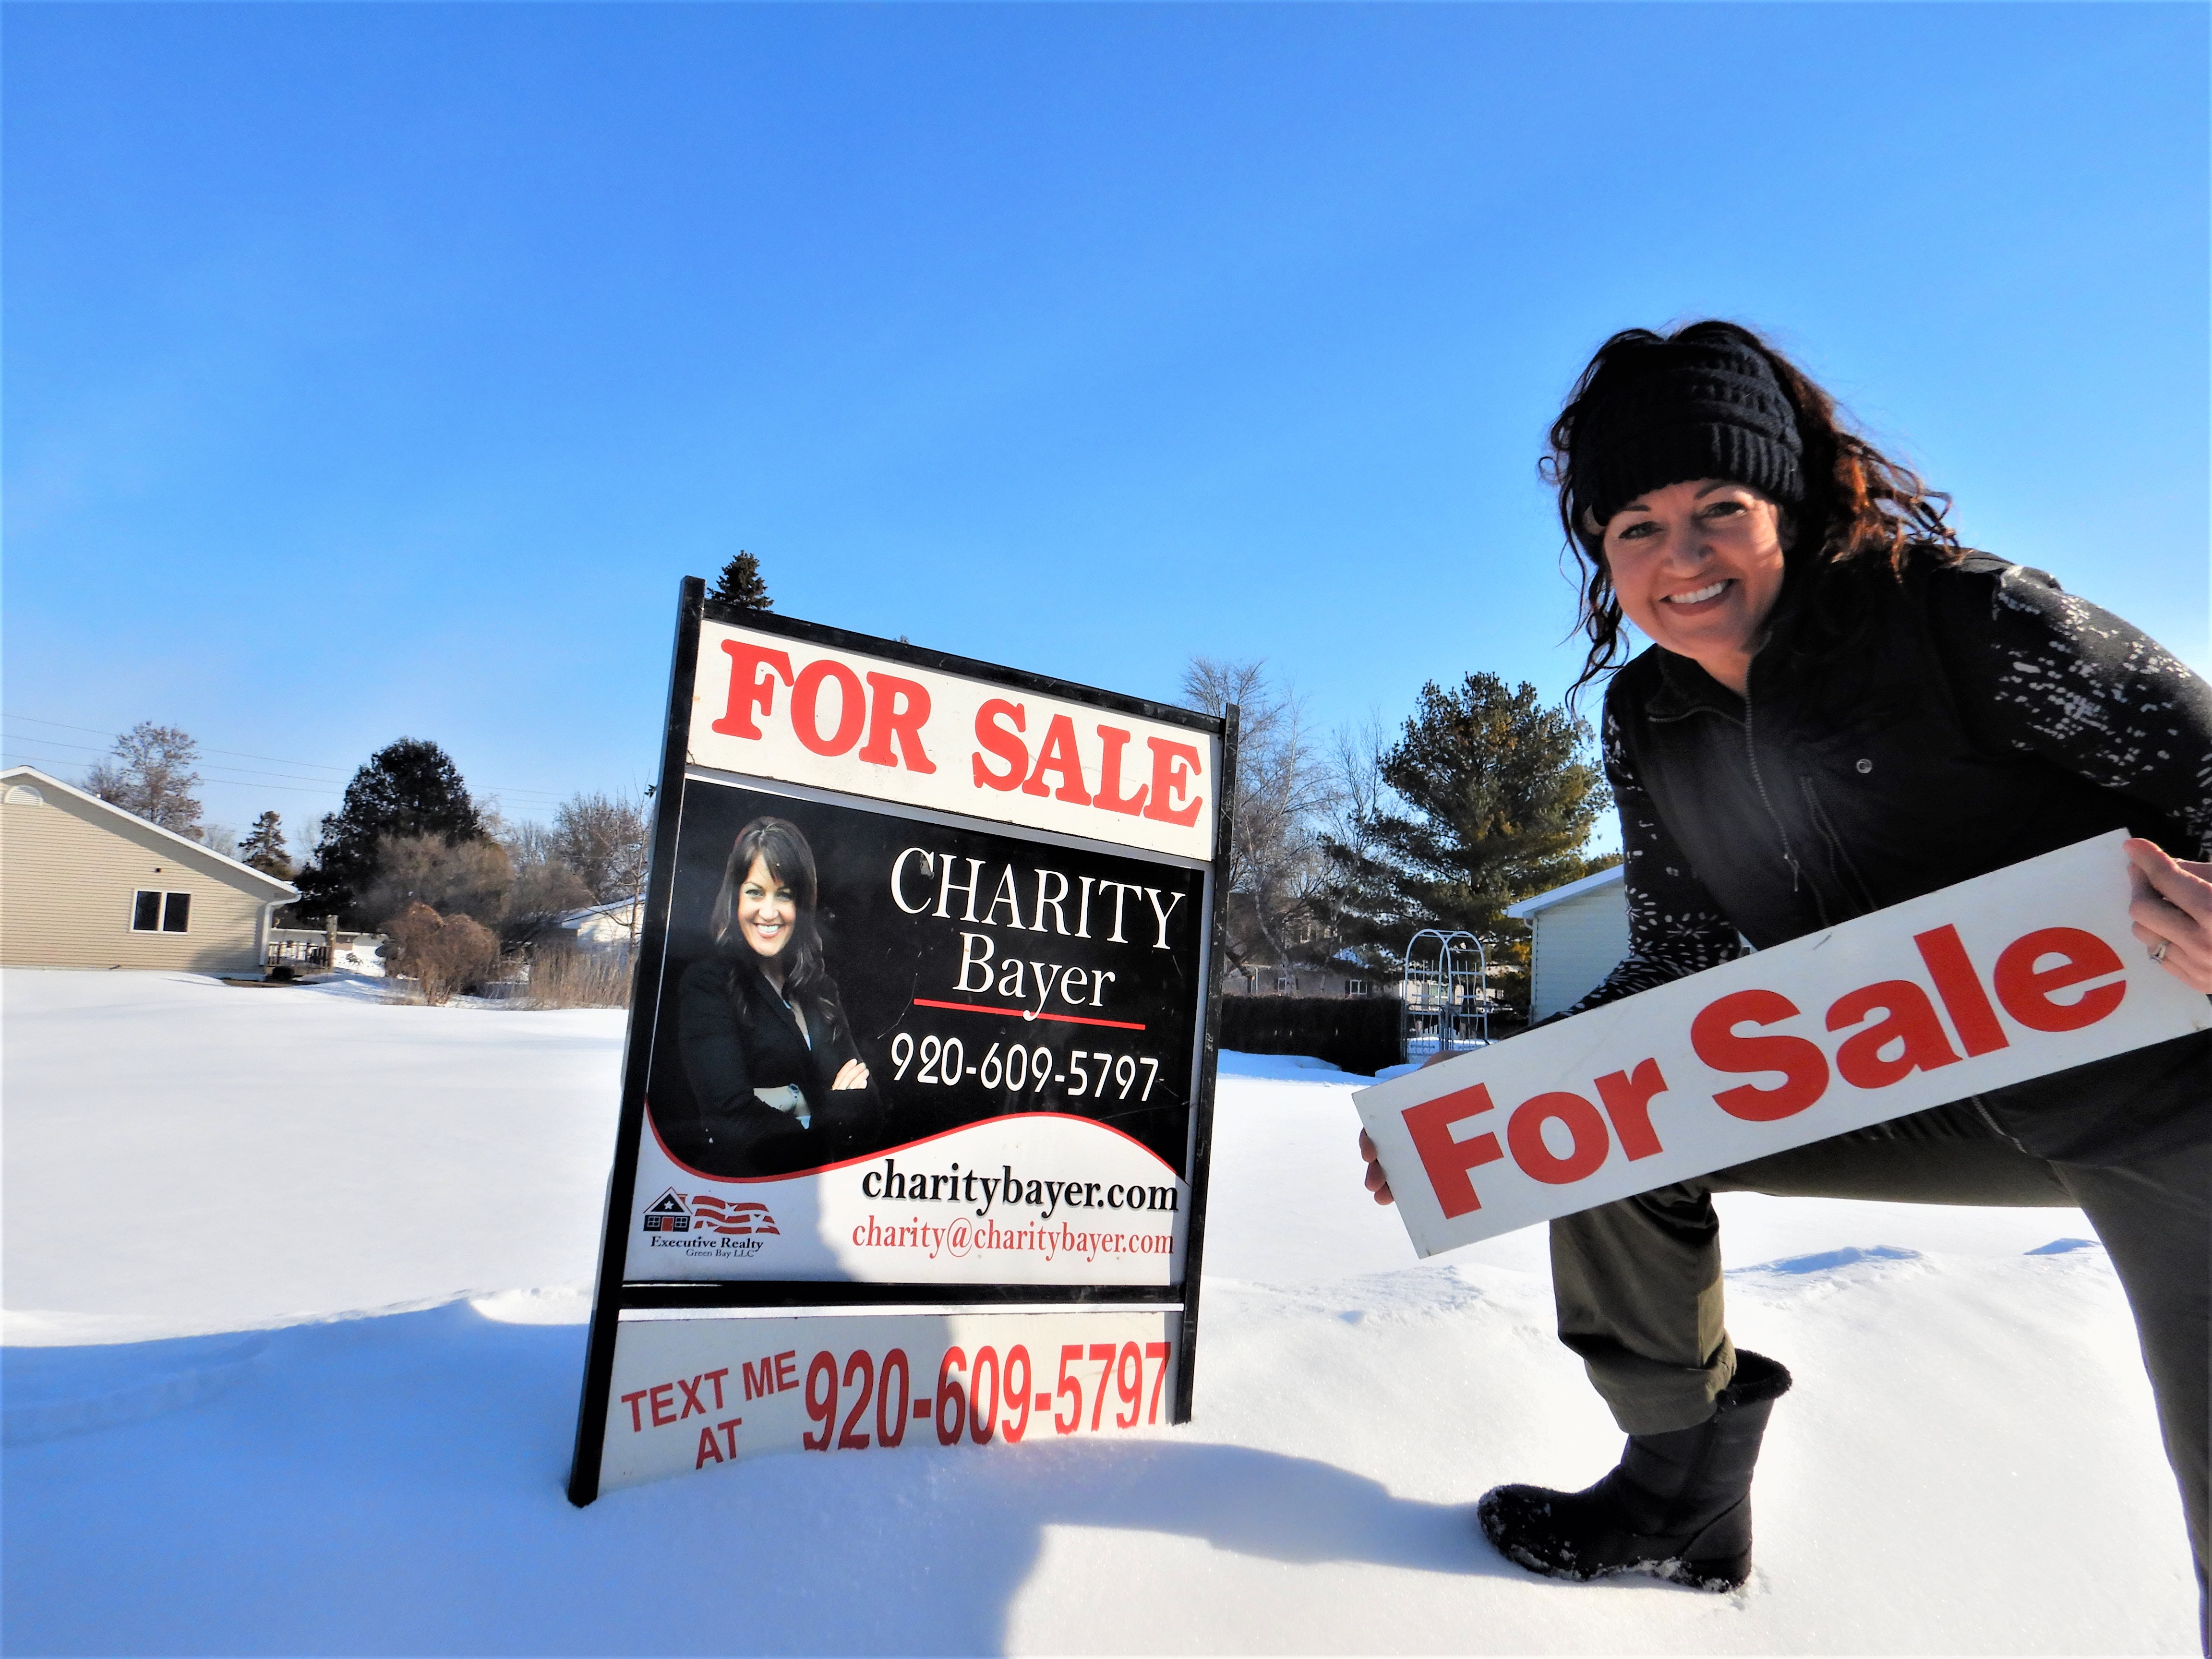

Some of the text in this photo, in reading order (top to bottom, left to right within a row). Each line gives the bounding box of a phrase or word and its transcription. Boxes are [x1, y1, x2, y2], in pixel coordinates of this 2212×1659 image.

[712, 639, 1203, 828] FOR SALE
[890, 847, 1186, 950] CHARITY
[952, 932, 1116, 1022] Bayer
[890, 1032, 1159, 1102] 920-609-5797
[1401, 923, 2127, 1220] For Sale
[862, 1158, 1179, 1219] charitybayer.com
[651, 1236, 764, 1251] Executive Realty
[686, 1249, 755, 1259] Green Bay LLC
[852, 1215, 1174, 1262] charity@charitybayer.com
[621, 1341, 1172, 1453] TEXT ME 920-609-5797
[695, 1418, 742, 1470] AT
